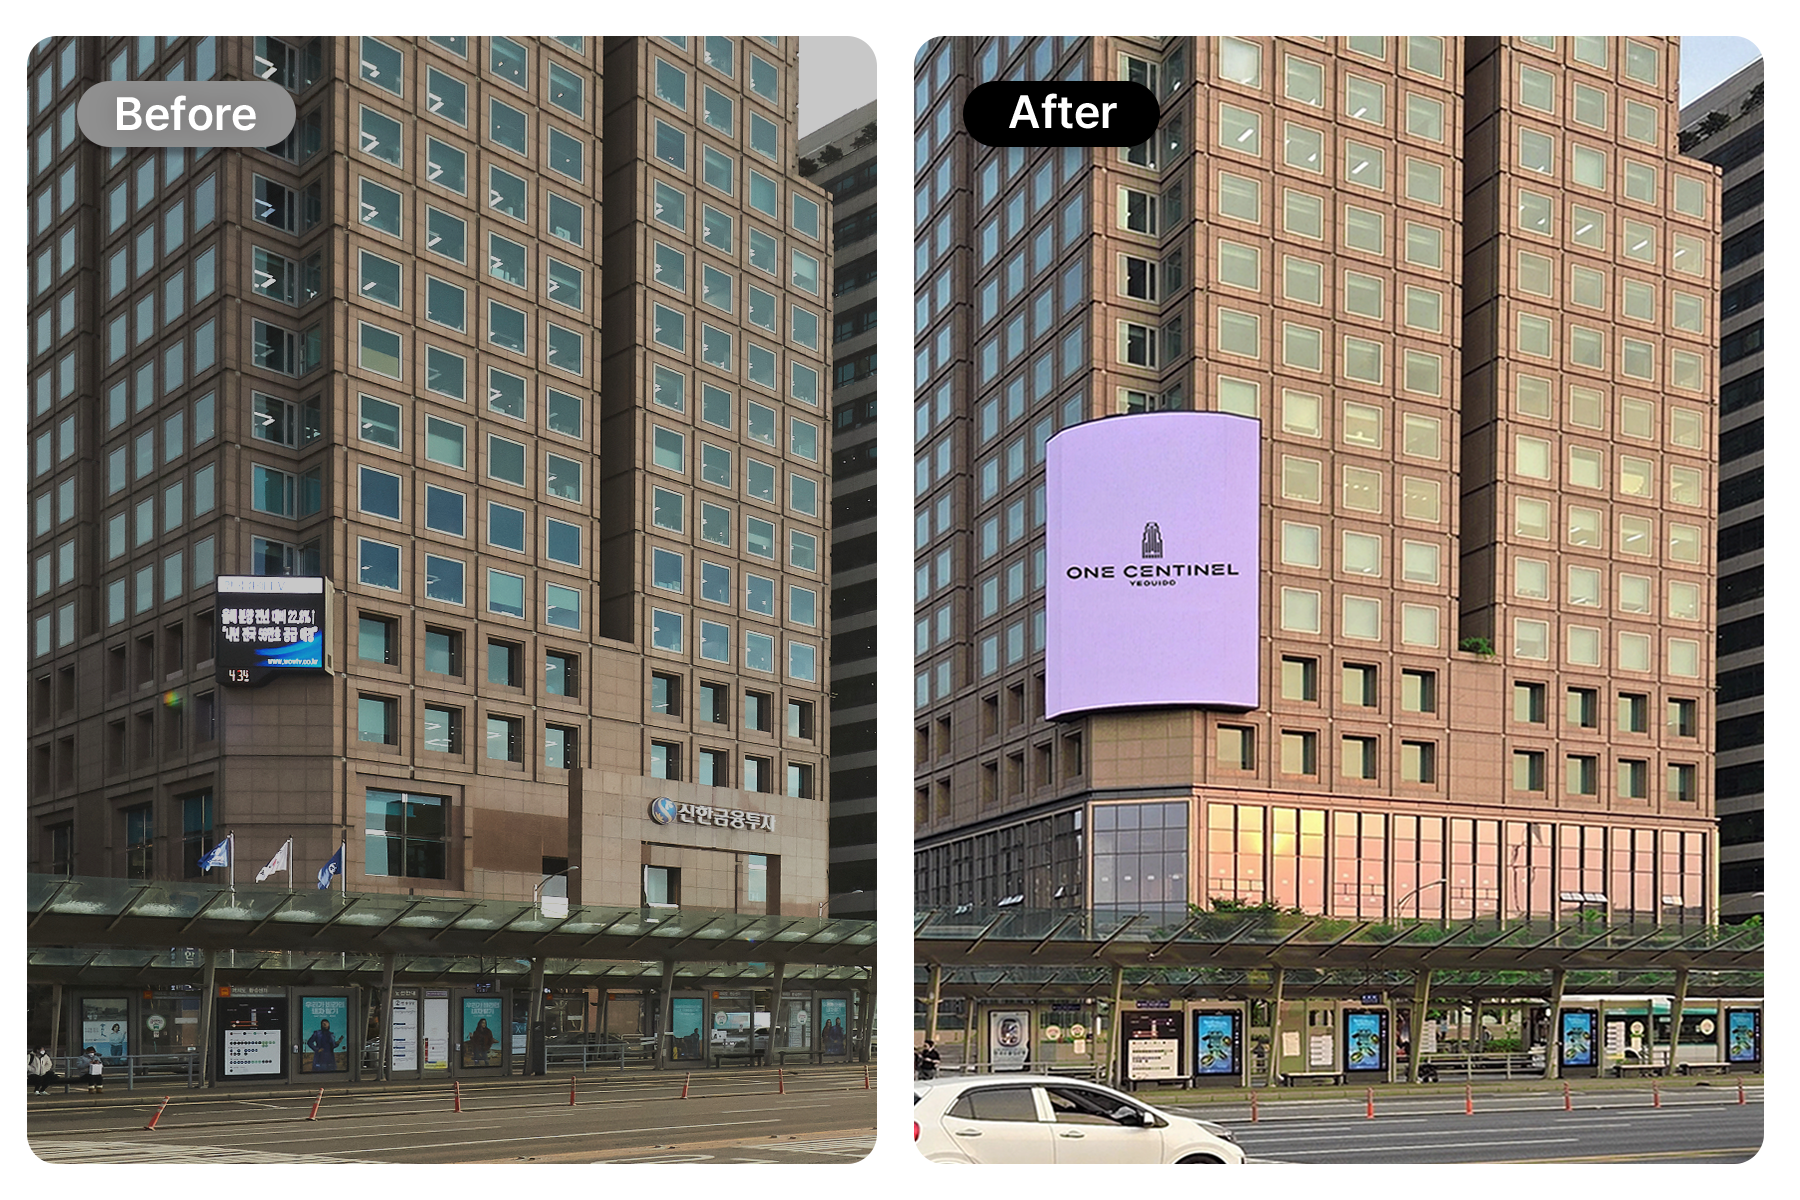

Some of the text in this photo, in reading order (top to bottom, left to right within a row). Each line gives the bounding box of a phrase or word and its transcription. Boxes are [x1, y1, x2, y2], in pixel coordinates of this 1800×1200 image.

[1066, 563, 1240, 579] ONE CENTINEL
[1129, 579, 1177, 587] YEOUIDO
[678, 803, 777, 832] 신한금융투자
